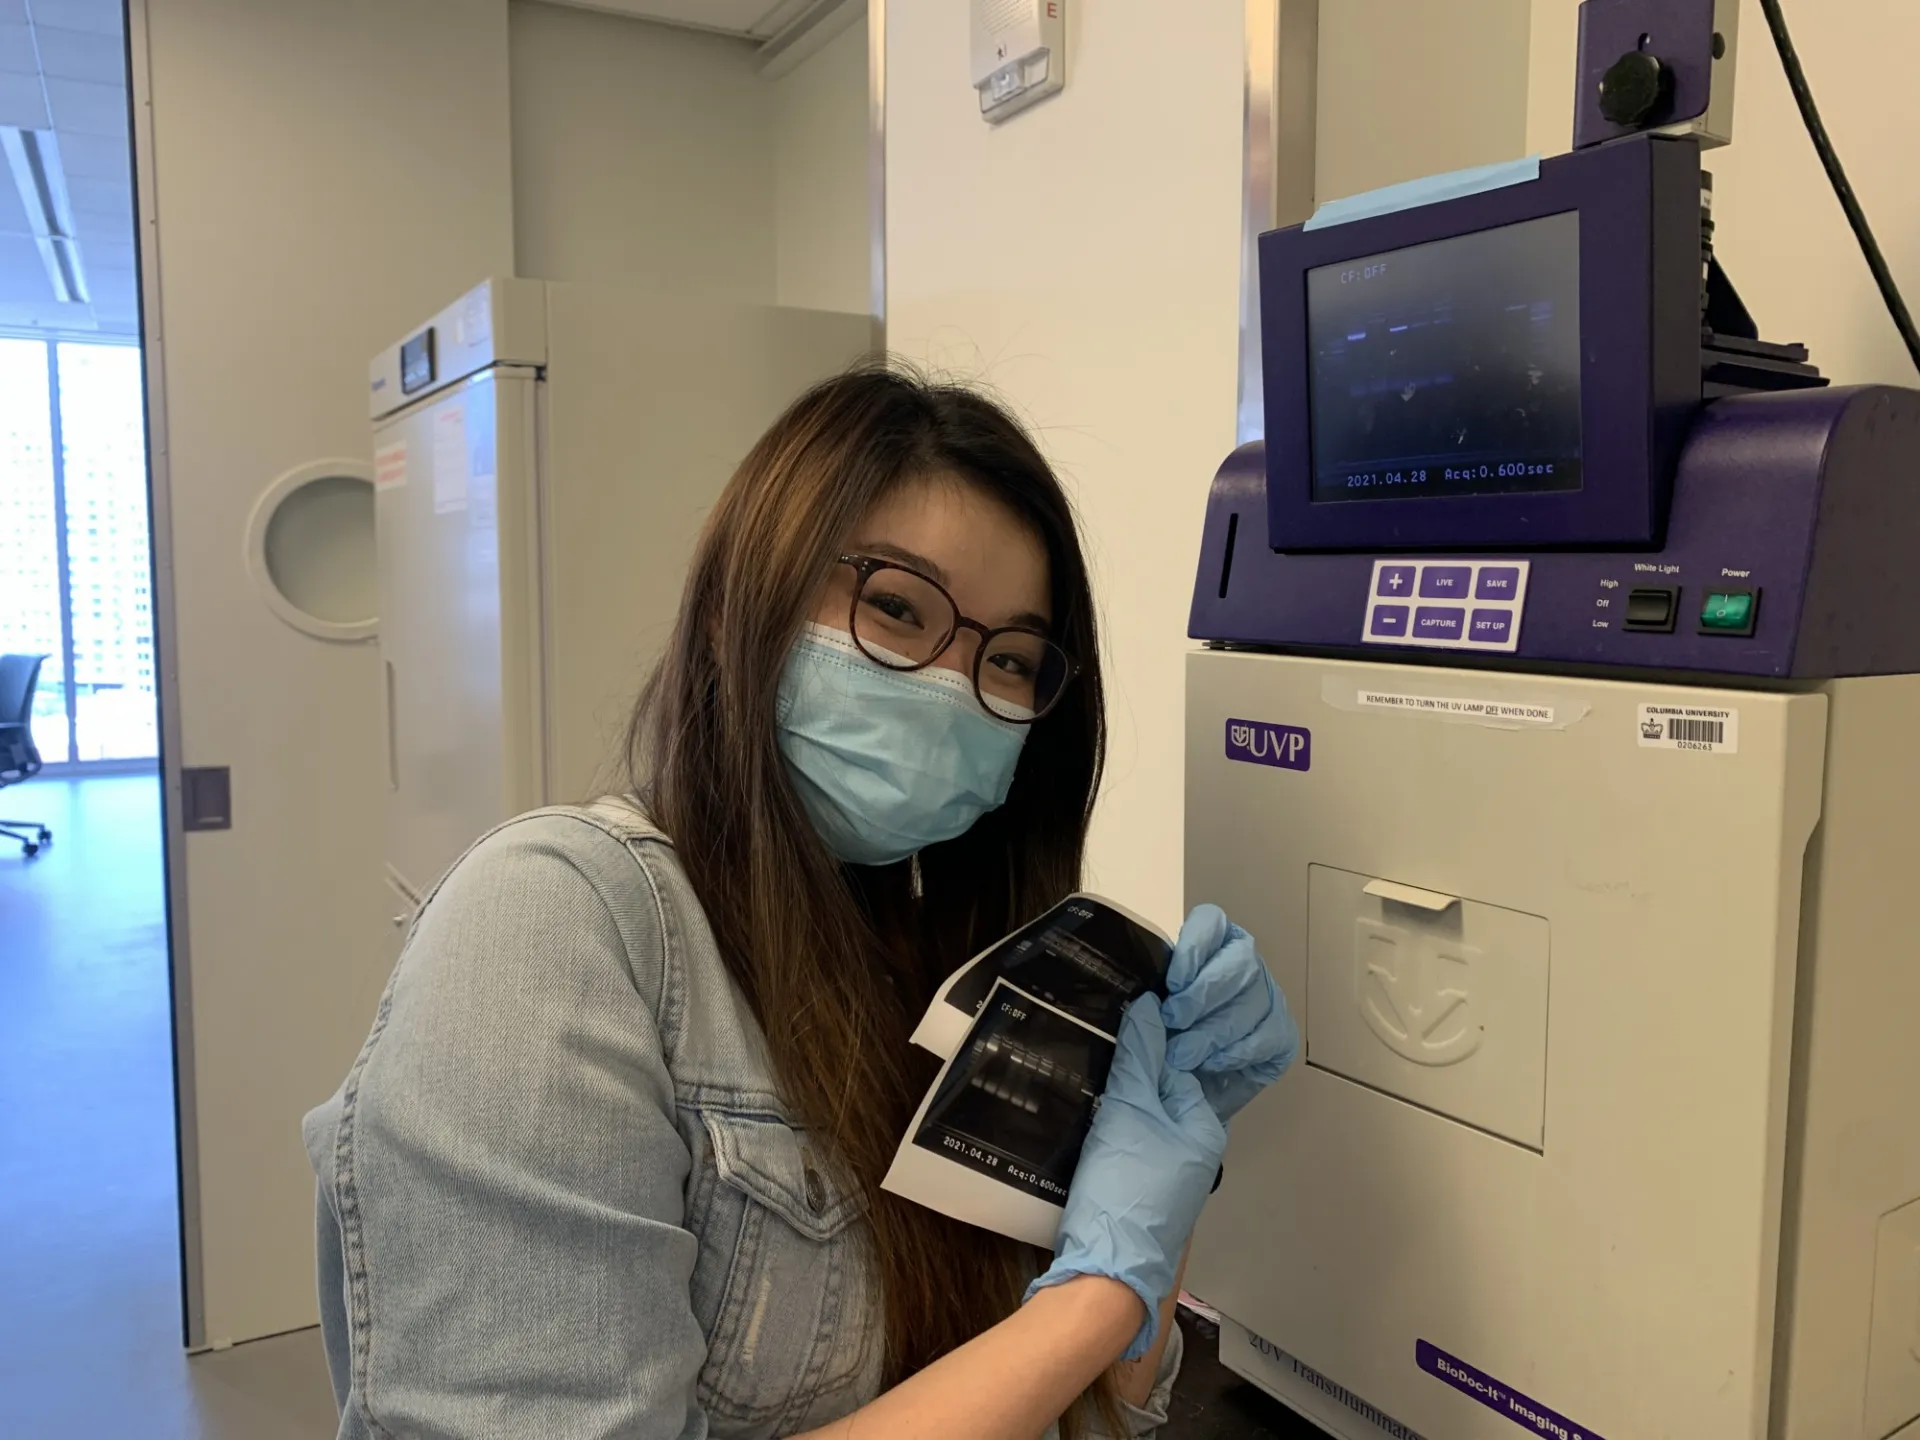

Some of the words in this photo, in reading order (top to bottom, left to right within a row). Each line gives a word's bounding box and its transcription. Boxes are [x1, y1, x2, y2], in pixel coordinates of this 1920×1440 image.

[1340, 263, 1388, 284] CF:OFF
[1347, 470, 1427, 487] 2021.04.28
[1444, 463, 1554, 480] Acq:0.600sec
[1634, 563, 1657, 572] White
[1658, 564, 1680, 574] Light
[1721, 568, 1750, 578] Power
[1436, 578, 1454, 587] LIVE
[1486, 579, 1508, 588] SAVE
[1600, 579, 1619, 589] High
[1596, 599, 1610, 608] Off
[1420, 618, 1457, 628] CAPTURE
[1475, 621, 1491, 630] SET
[1492, 622, 1506, 631] UP
[1592, 619, 1609, 628] Low
[1366, 695, 1403, 705] REMEMBER
[1404, 698, 1415, 706] TO
[1416, 699, 1435, 709] TURN
[1436, 701, 1450, 710] THE
[1451, 702, 1462, 711] UV
[1463, 703, 1484, 713] LAMP
[1485, 705, 1499, 715] OFF
[1500, 706, 1525, 716] WHEN
[1526, 708, 1551, 719] DONE.
[1646, 706, 1684, 715] COLUMBIA
[1685, 709, 1730, 718] UNIVERSITY
[1249, 727, 1305, 762] UVP
[1677, 741, 1712, 751] 0206263
[1066, 905, 1094, 919] CF:OFF
[1001, 1002, 1027, 1021] CF:OFF
[943, 1136, 999, 1166] 2021.04.28
[1007, 1164, 1068, 1196] Acq:0.600sec
[1509, 1398, 1569, 1440] Imaging
